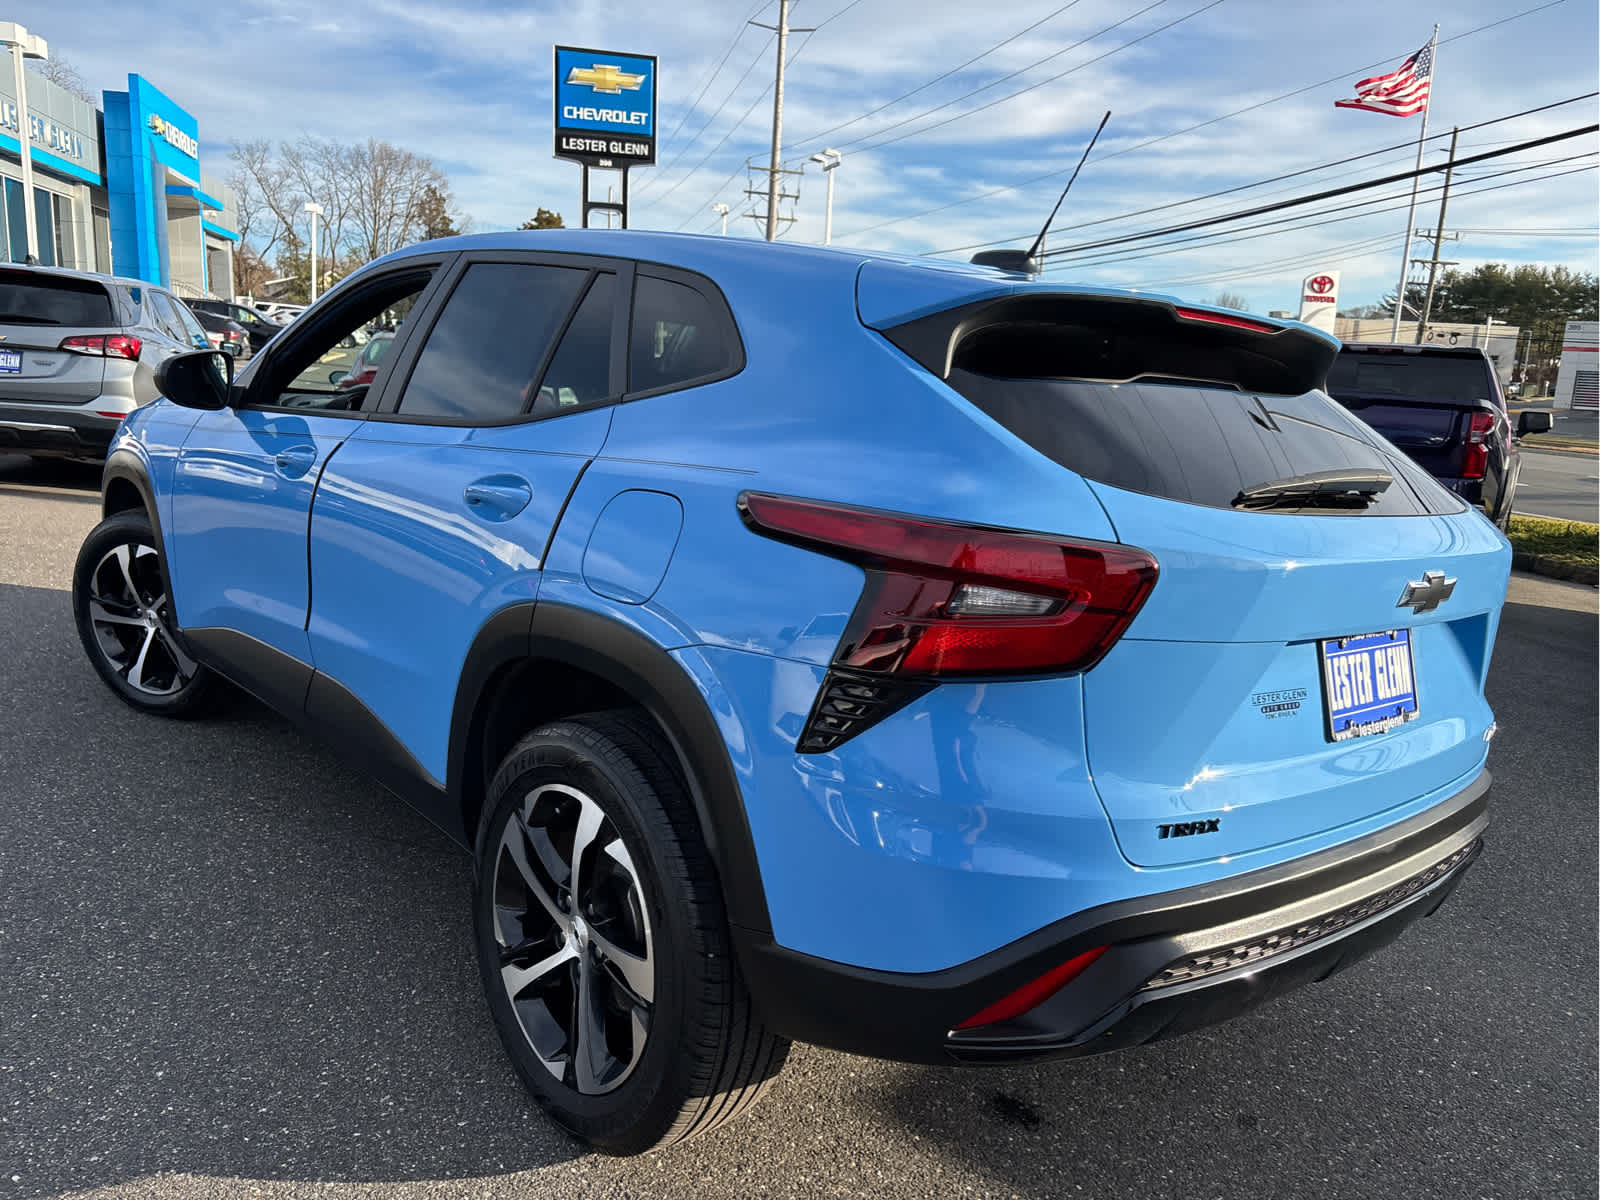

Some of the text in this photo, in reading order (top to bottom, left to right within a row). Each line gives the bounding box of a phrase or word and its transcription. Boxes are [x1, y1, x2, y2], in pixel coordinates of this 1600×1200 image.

[0, 100, 46, 144] LEER
[563, 106, 648, 125] CHEVROLET
[165, 120, 199, 160] CHEVROLET
[562, 137, 649, 156] LESTER GLENN
[1305, 295, 1335, 303] TOYOTA
[1327, 645, 1411, 711] LESTER GLENN
[1251, 689, 1307, 705] LESTER GLENN
[1335, 711, 1419, 741] wwwlesterglenncom
[1155, 818, 1221, 840] TRAX
